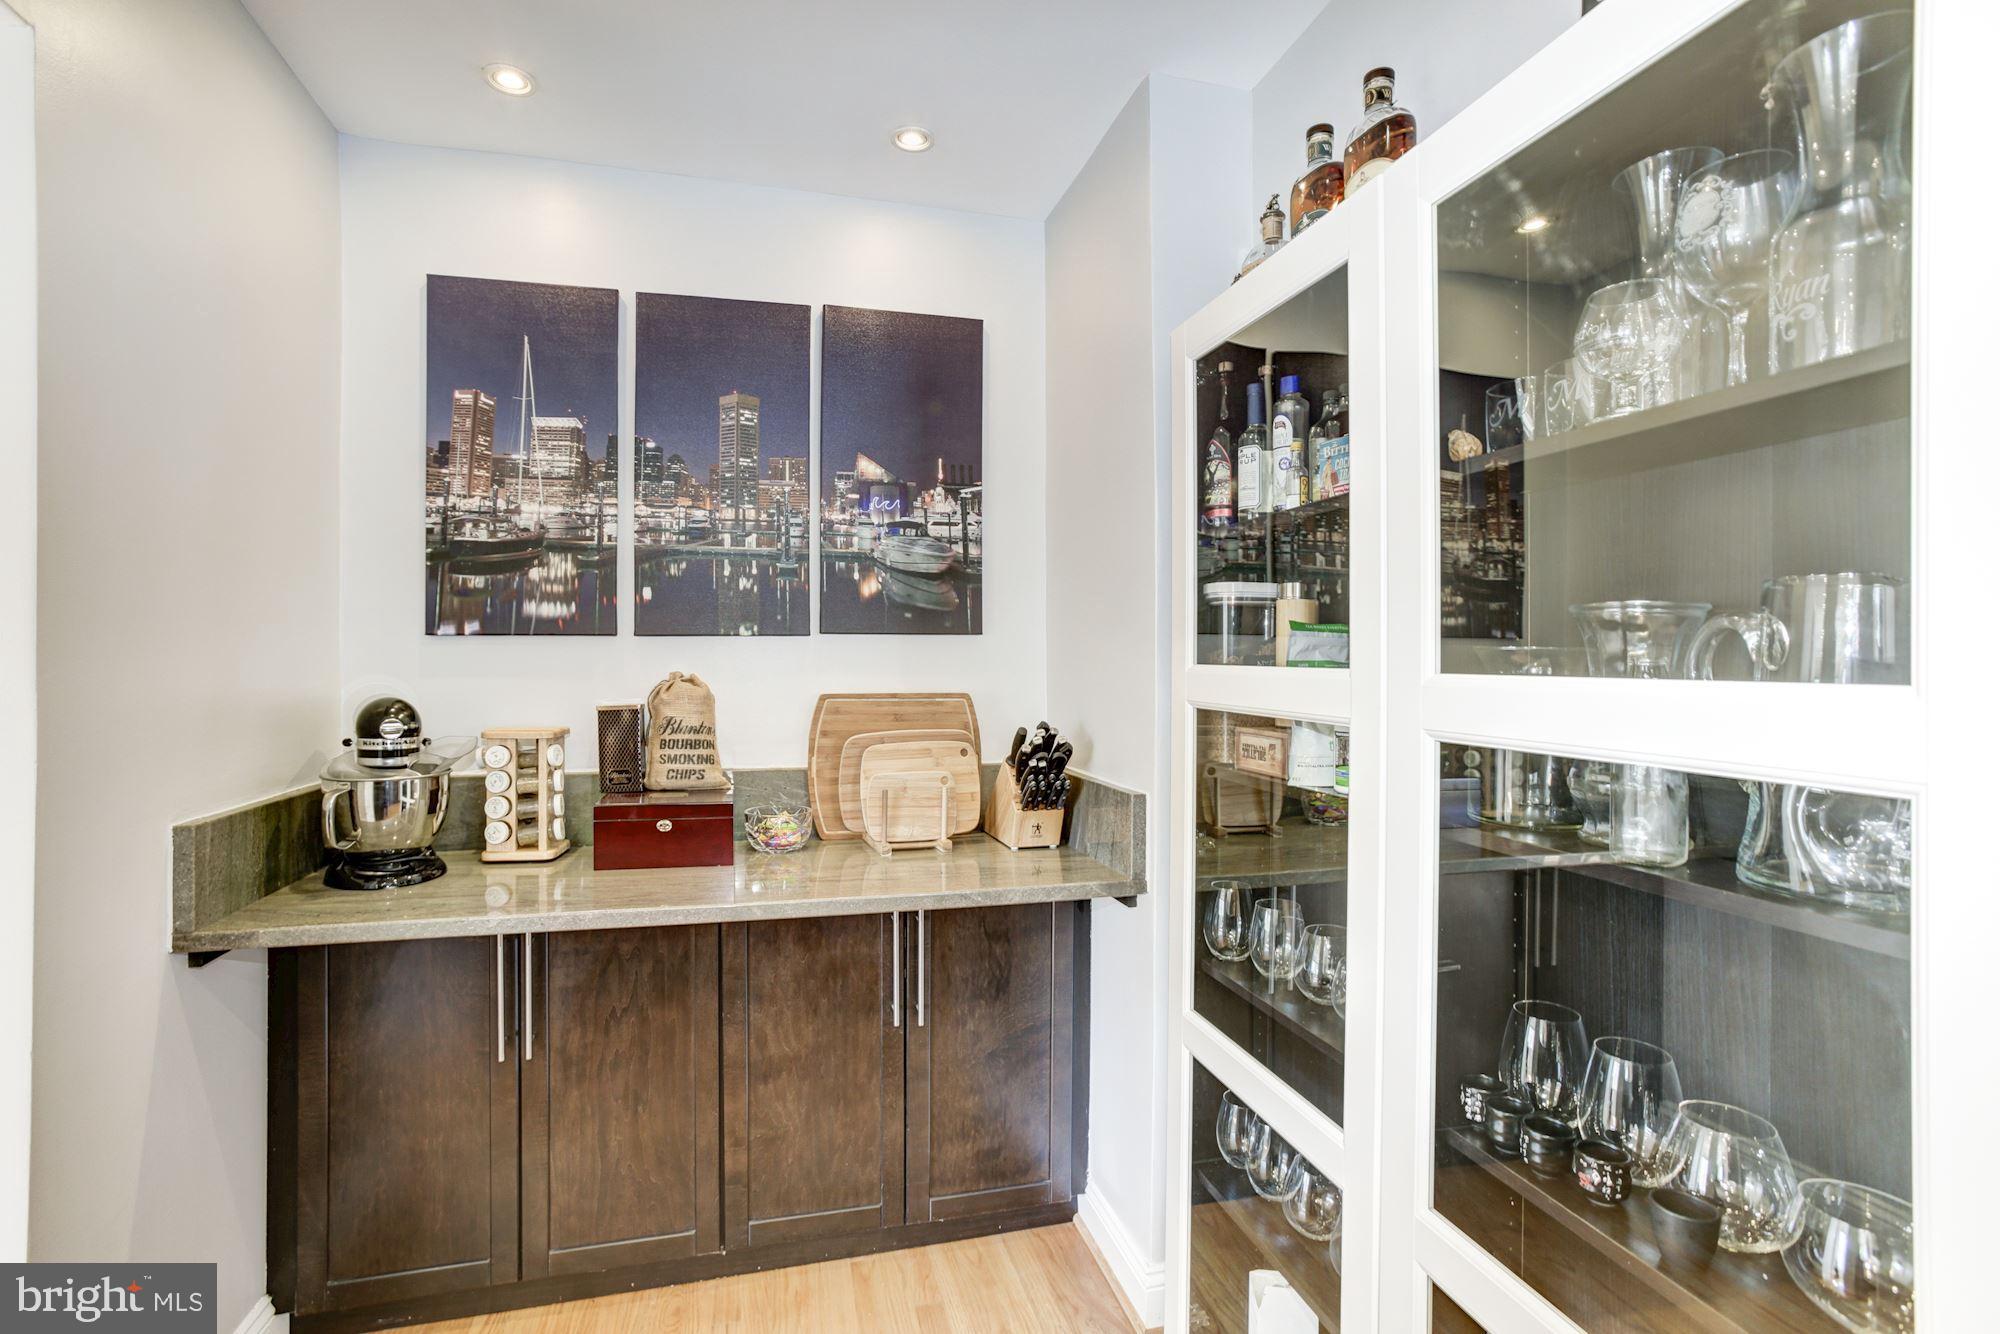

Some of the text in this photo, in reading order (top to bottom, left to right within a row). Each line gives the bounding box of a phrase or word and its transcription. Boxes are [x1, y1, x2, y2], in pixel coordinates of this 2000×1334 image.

[659, 738, 715, 750] BOURBON
[659, 753, 715, 765] SMOKING
[666, 768, 706, 780] CHIPS
